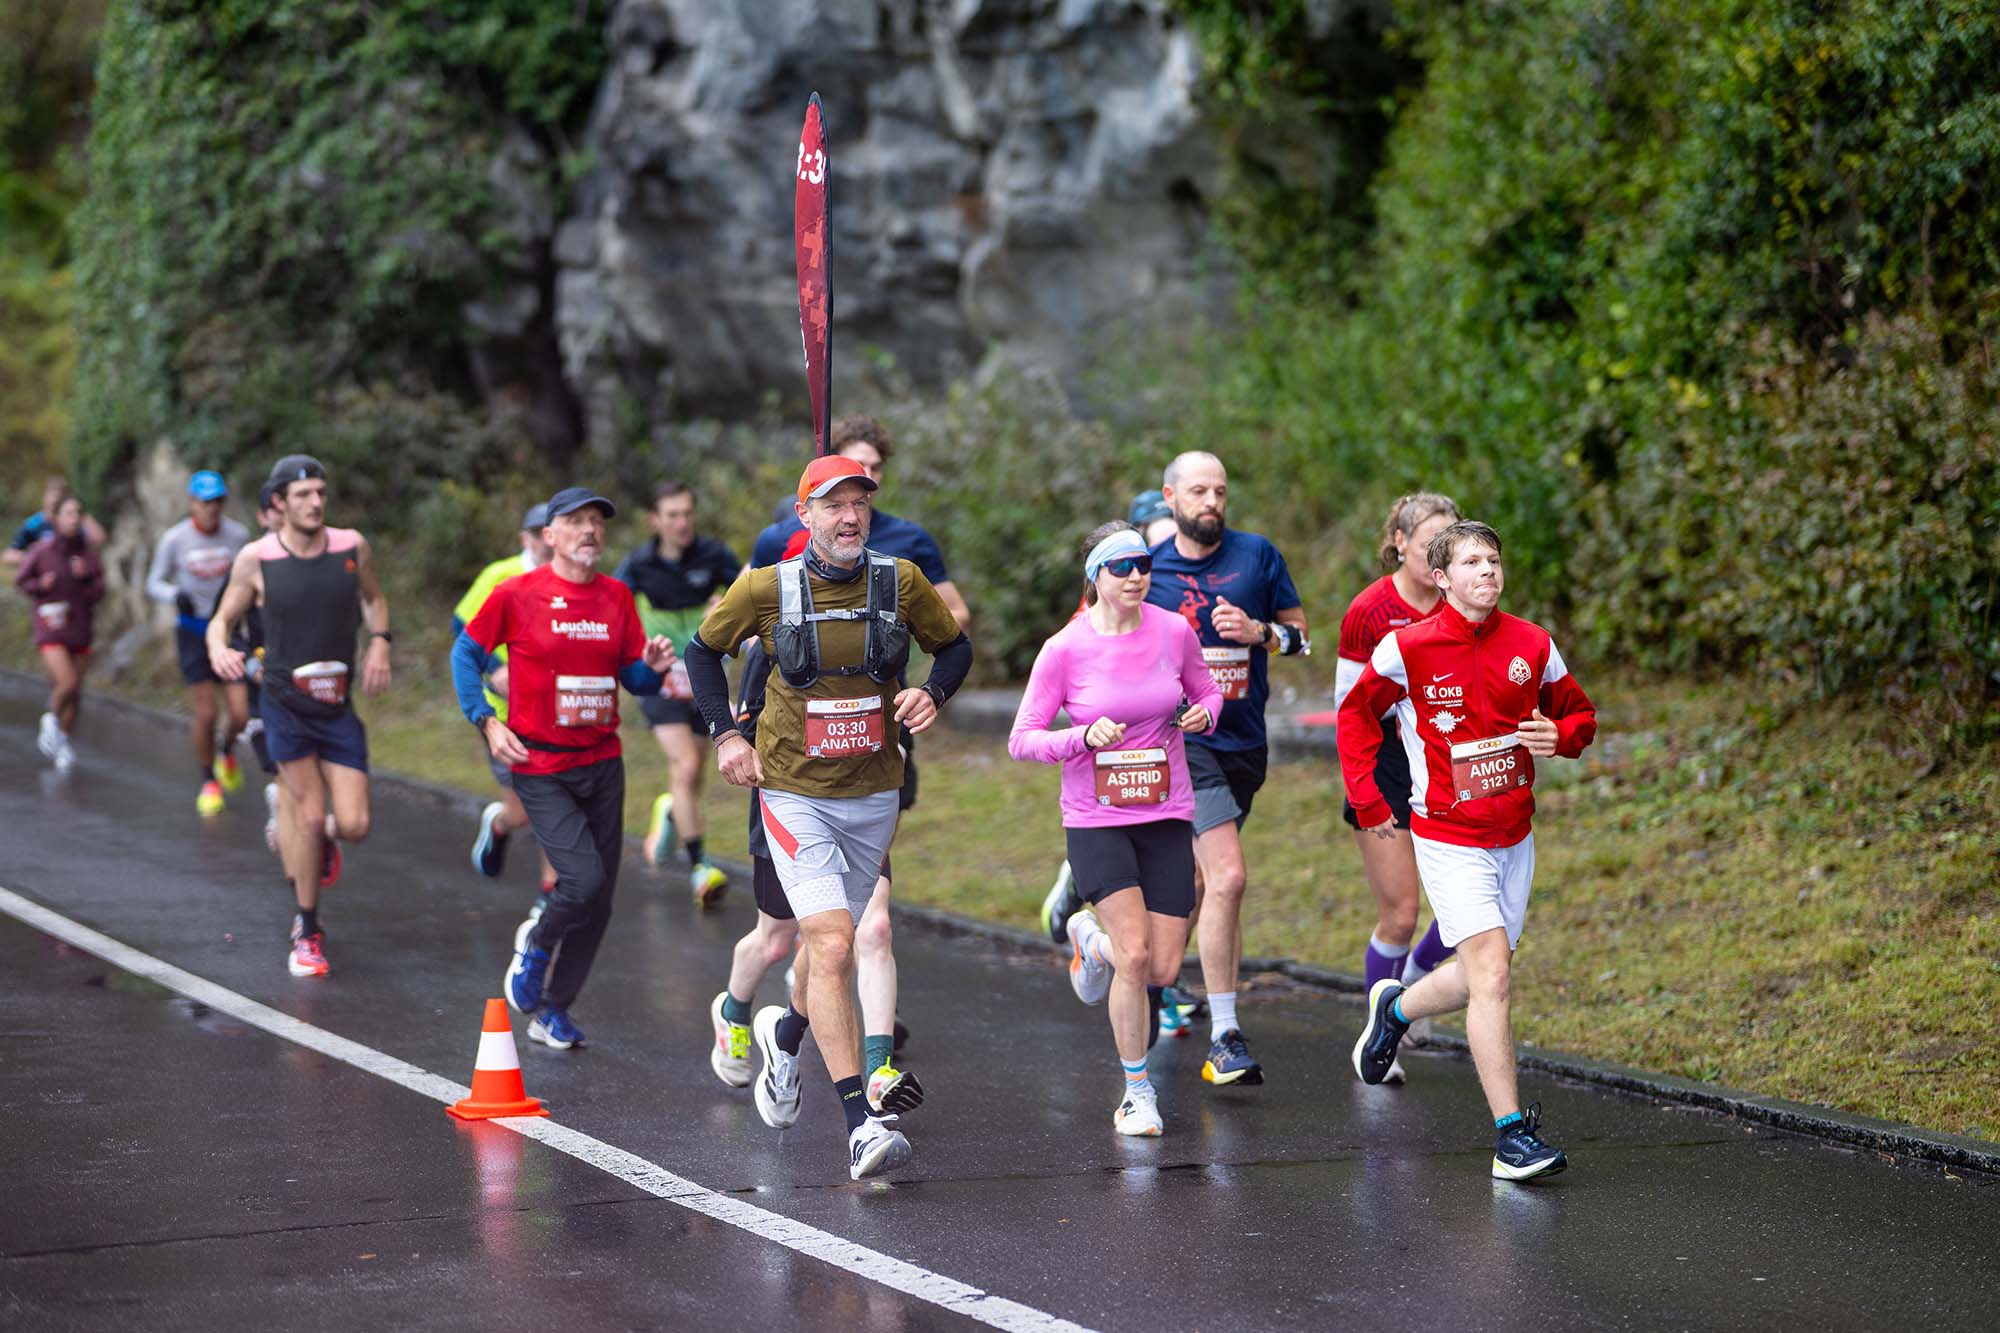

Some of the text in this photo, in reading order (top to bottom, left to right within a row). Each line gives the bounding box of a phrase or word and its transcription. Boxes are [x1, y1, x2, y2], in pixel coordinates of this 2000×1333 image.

[551, 618, 609, 633] Leuchter
[1438, 686, 1463, 698] OKB
[561, 695, 613, 709] MARKUS
[834, 701, 860, 710] coop
[827, 720, 867, 736] 03:30
[820, 735, 873, 750] ANATOL
[1478, 740, 1502, 749] coop
[1470, 756, 1516, 779] AMOS
[1107, 770, 1162, 786] ASTRID
[1481, 774, 1508, 790] 3121
[1121, 786, 1150, 799] 9843
